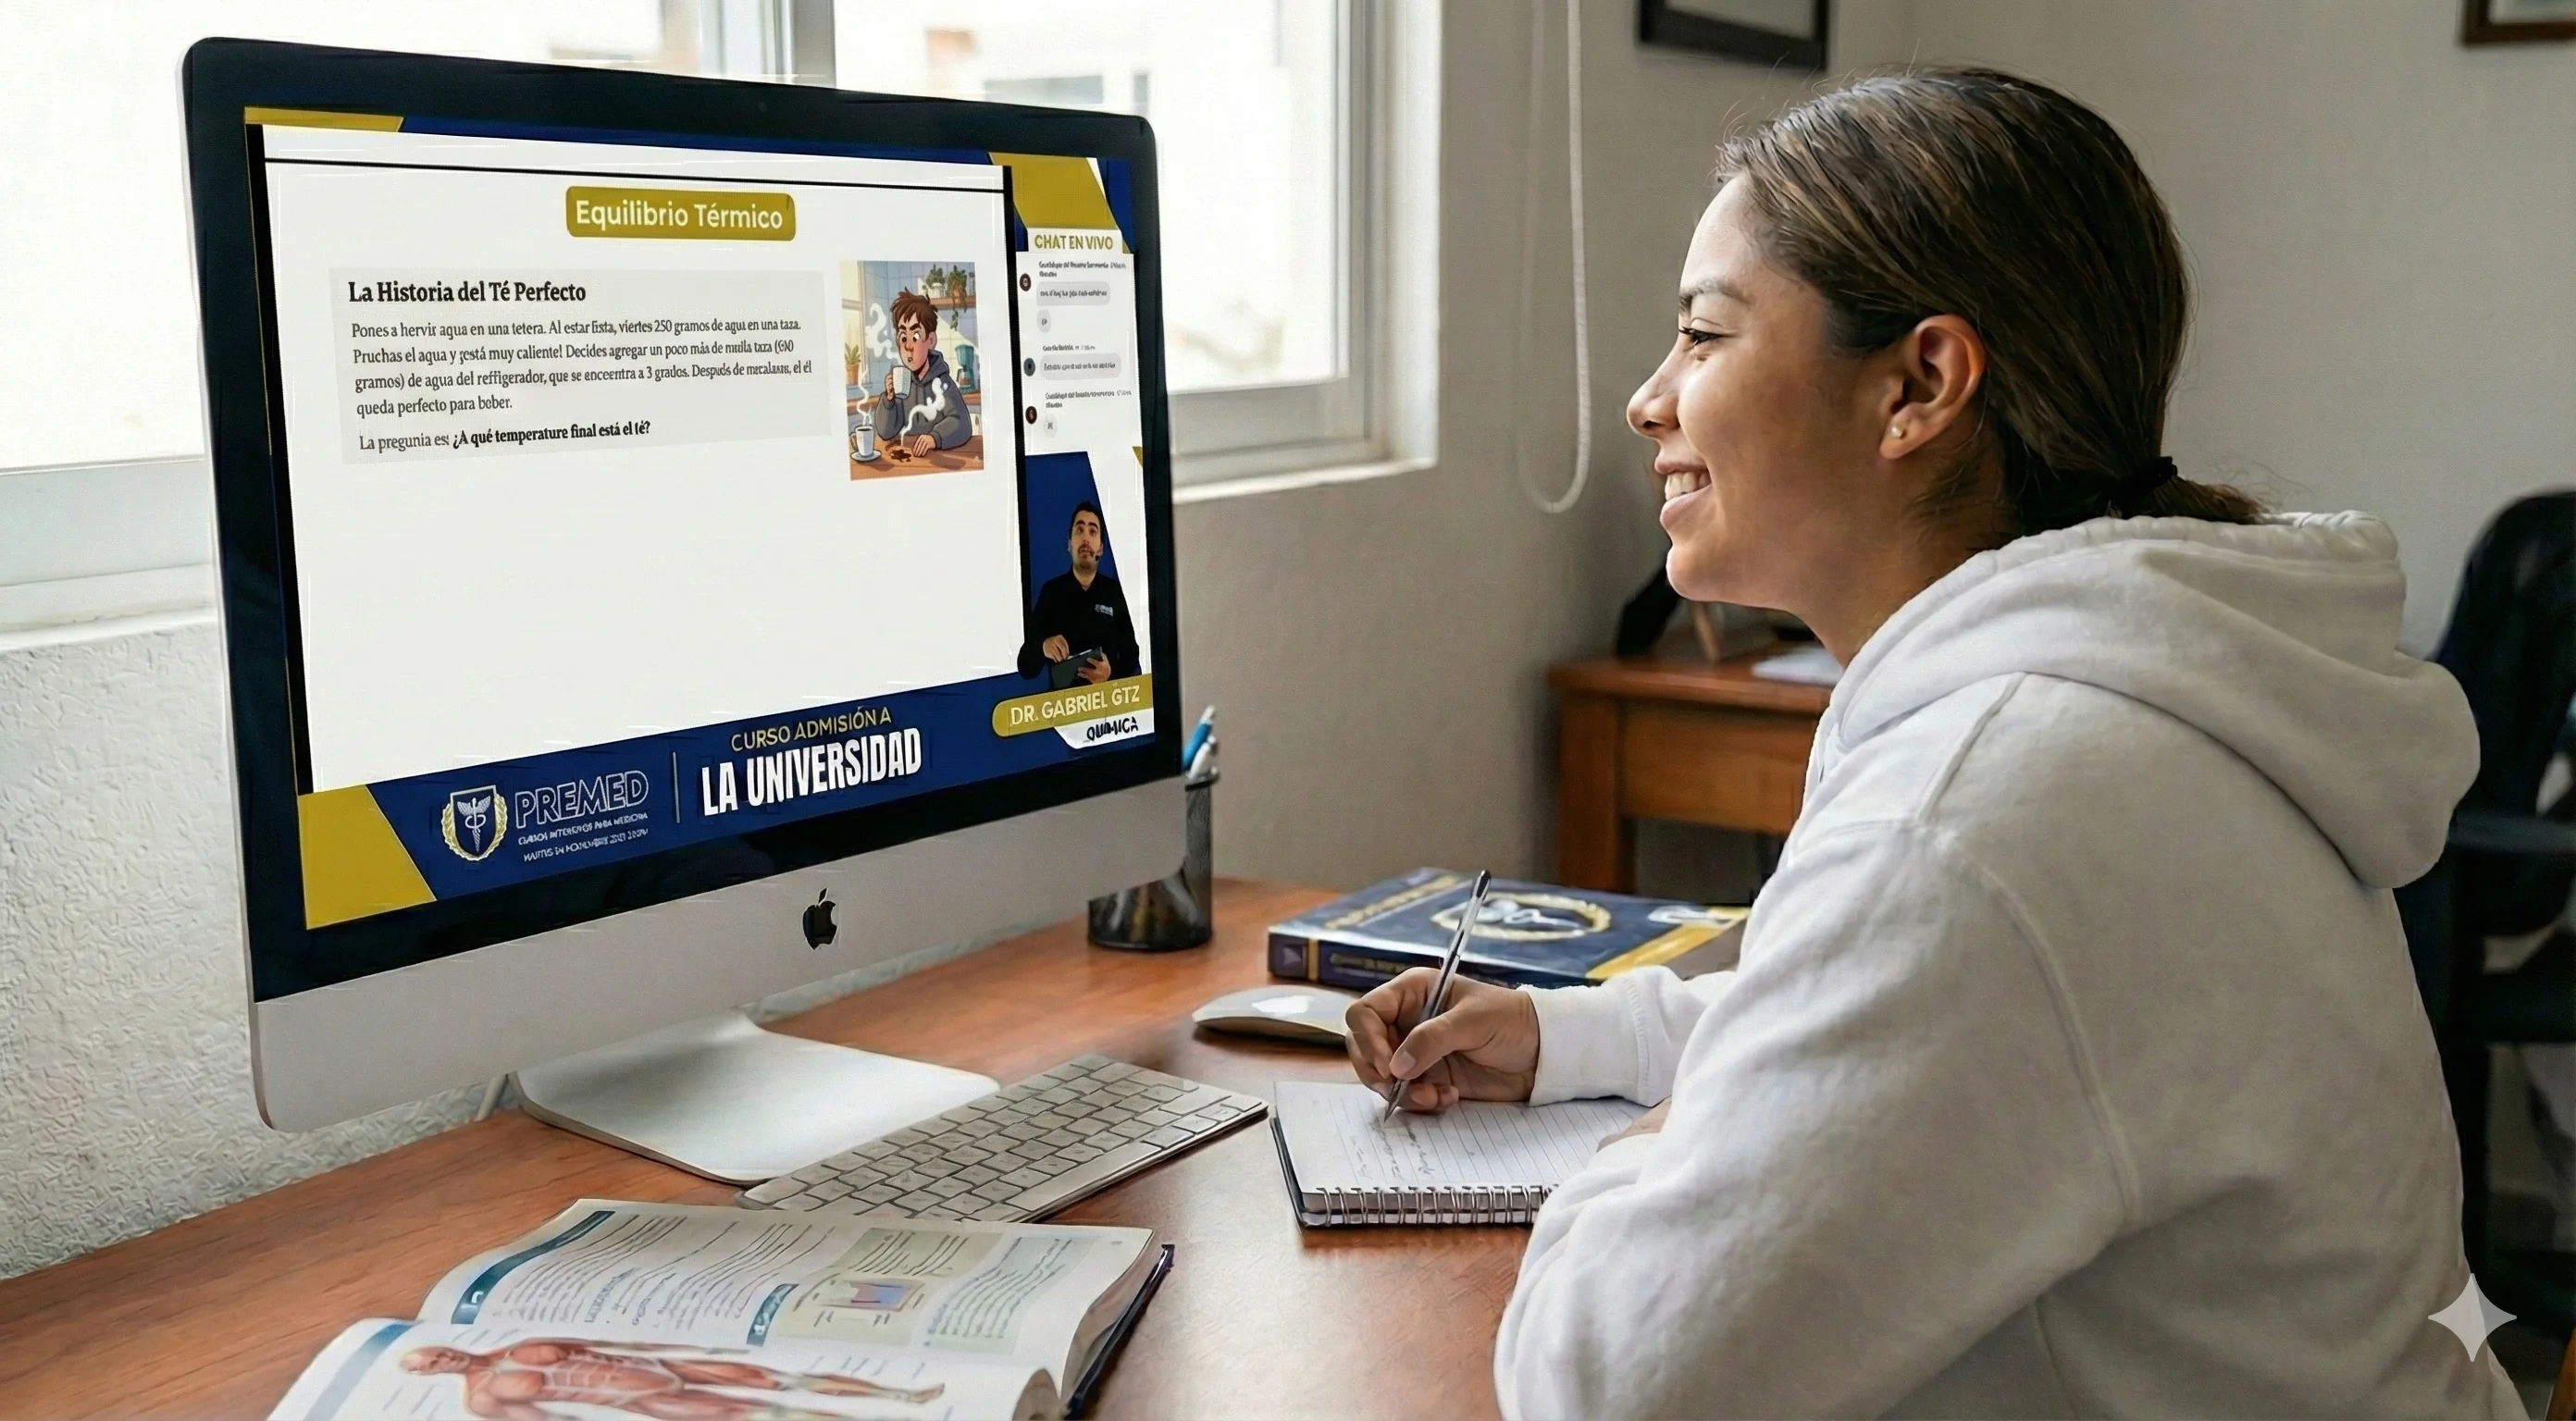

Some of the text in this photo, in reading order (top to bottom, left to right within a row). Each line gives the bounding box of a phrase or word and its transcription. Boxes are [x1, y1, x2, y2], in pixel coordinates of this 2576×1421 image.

[576, 199, 784, 231] Equilibrio Térmico
[1034, 234, 1114, 250] CHAT EN VIVO
[348, 280, 586, 302] La Historia del Té Perfecto
[352, 324, 389, 337] Pones
[391, 327, 397, 337] a
[401, 323, 436, 337] hervir
[470, 326, 484, 335] en
[489, 326, 509, 335] una
[513, 324, 546, 335] tetera.
[550, 320, 561, 333] Al
[564, 322, 590, 334] estar
[654, 320, 672, 332] 250
[675, 323, 710, 336] gramos
[712, 318, 723, 330] de
[748, 322, 759, 330] en
[762, 321, 778, 329] una
[353, 348, 402, 364] Pruchas
[405, 347, 415, 362] el
[450, 351, 456, 365] y
[489, 350, 514, 364] muy
[517, 344, 563, 359] caliente!
[566, 344, 607, 357] Decides
[609, 347, 648, 360] agregar
[650, 346, 663, 355] un
[665, 346, 687, 359] poco
[712, 341, 723, 353] de
[355, 374, 404, 393] gramos)
[408, 373, 422, 387] de
[426, 377, 453, 390] agua
[457, 371, 474, 385] del
[549, 373, 568, 386] que
[572, 372, 581, 381] se
[638, 370, 644, 378] a
[647, 366, 652, 378] 3
[733, 363, 744, 375] de
[357, 400, 394, 419] queda
[398, 398, 446, 417] perfecto
[450, 401, 475, 414] para
[360, 436, 375, 450] La
[453, 430, 468, 449] ¿A
[471, 428, 493, 448] qué
[495, 428, 568, 445] temperature
[571, 424, 596, 438] final
[599, 422, 621, 437] está
[623, 421, 633, 435] el
[1010, 685, 1140, 726] DR. GABRIEL GTZ
[731, 706, 892, 751] CURSO ADMISIÓN A
[701, 727, 922, 816] LA UNIVERSIDAD
[514, 770, 649, 829] PREMED
